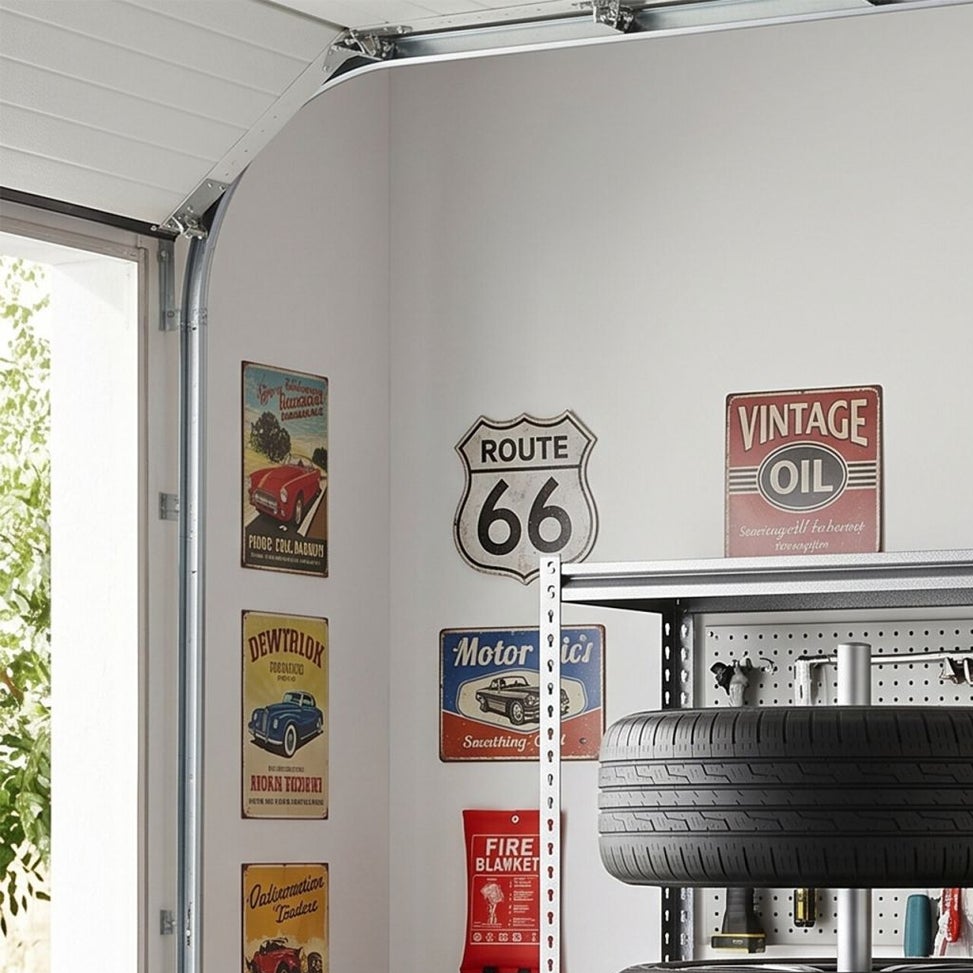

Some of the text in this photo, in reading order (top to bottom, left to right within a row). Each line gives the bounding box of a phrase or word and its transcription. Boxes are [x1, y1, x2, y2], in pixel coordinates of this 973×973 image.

[738, 398, 869, 452] VINTAGE
[481, 435, 568, 463] ROUTE
[769, 459, 834, 495] OIL
[477, 476, 572, 556] 66
[453, 637, 534, 667] Motor
[485, 838, 534, 856] FIRE
